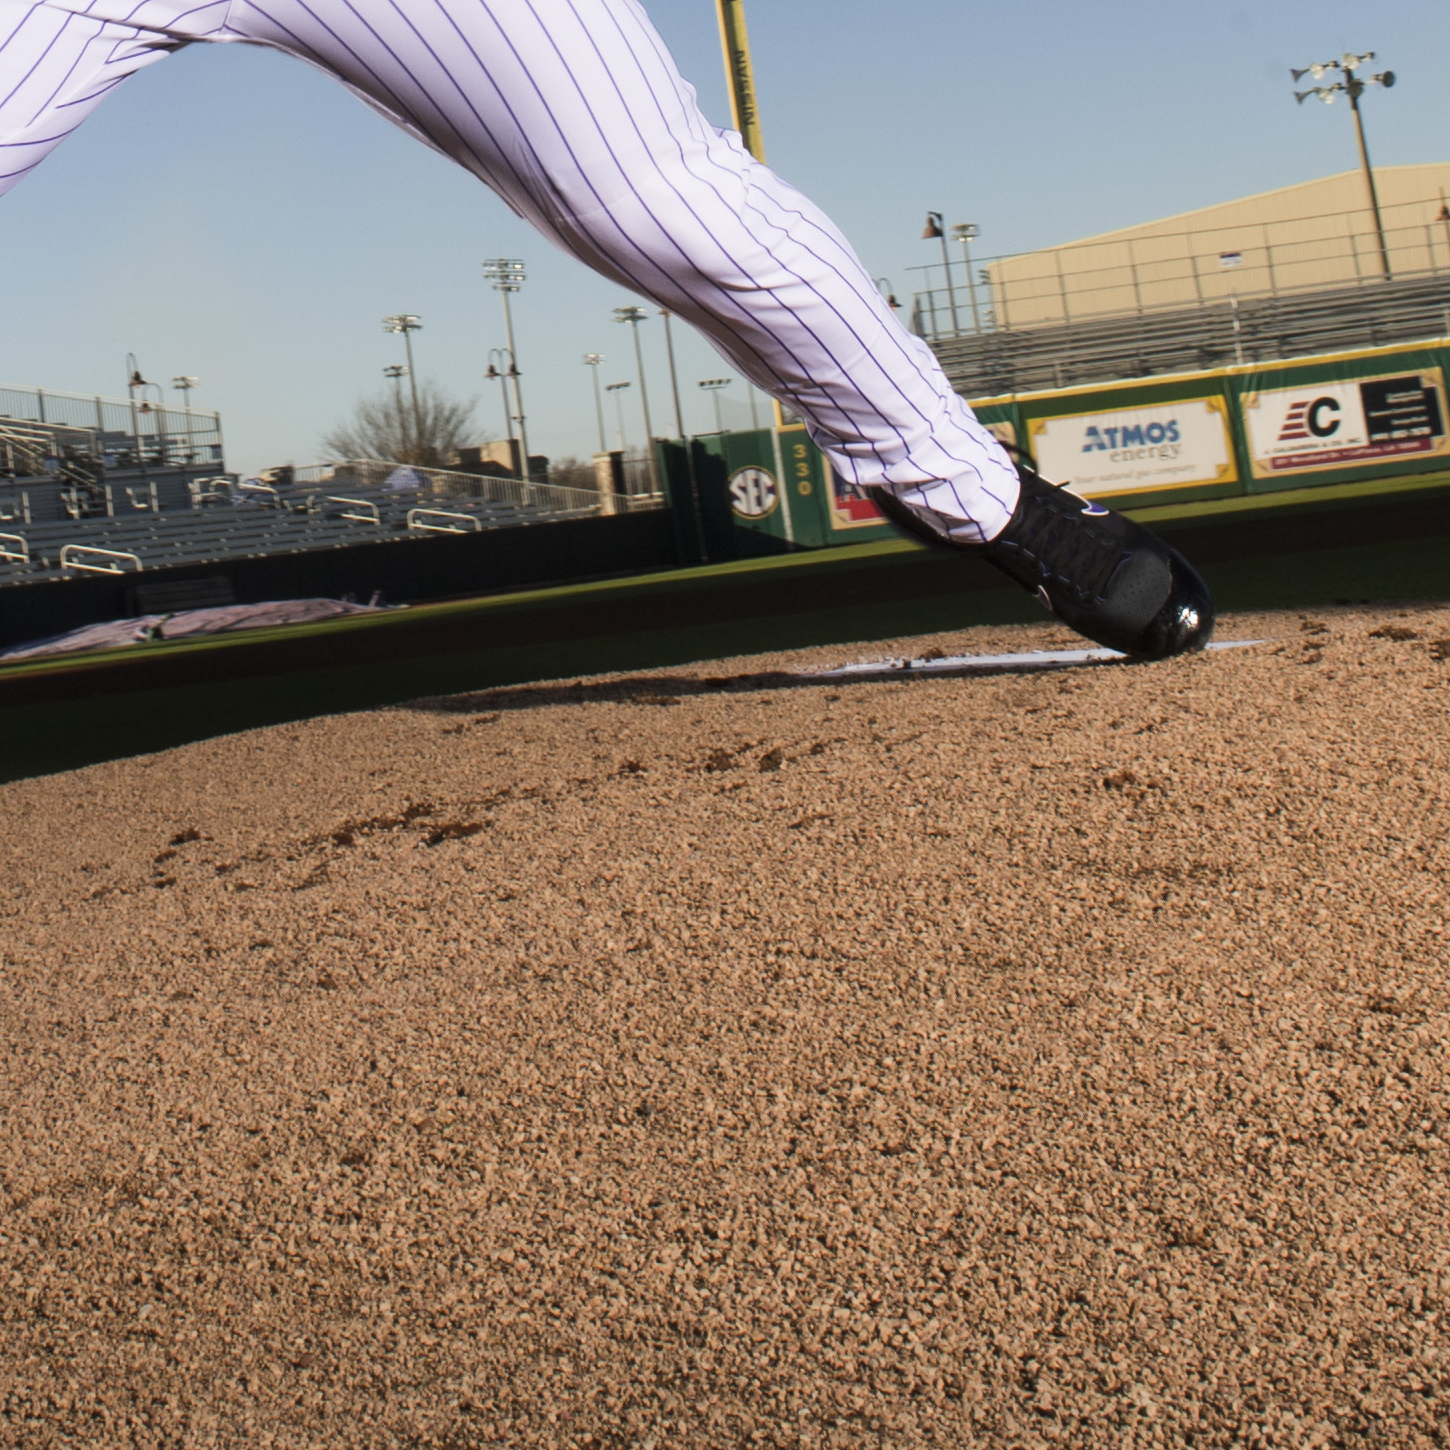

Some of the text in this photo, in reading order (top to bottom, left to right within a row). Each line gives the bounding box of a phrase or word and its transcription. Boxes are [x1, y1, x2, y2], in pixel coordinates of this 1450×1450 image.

[1308, 396, 1341, 438] C
[1082, 419, 1181, 452] ATMOS
[1109, 442, 1182, 462] energy
